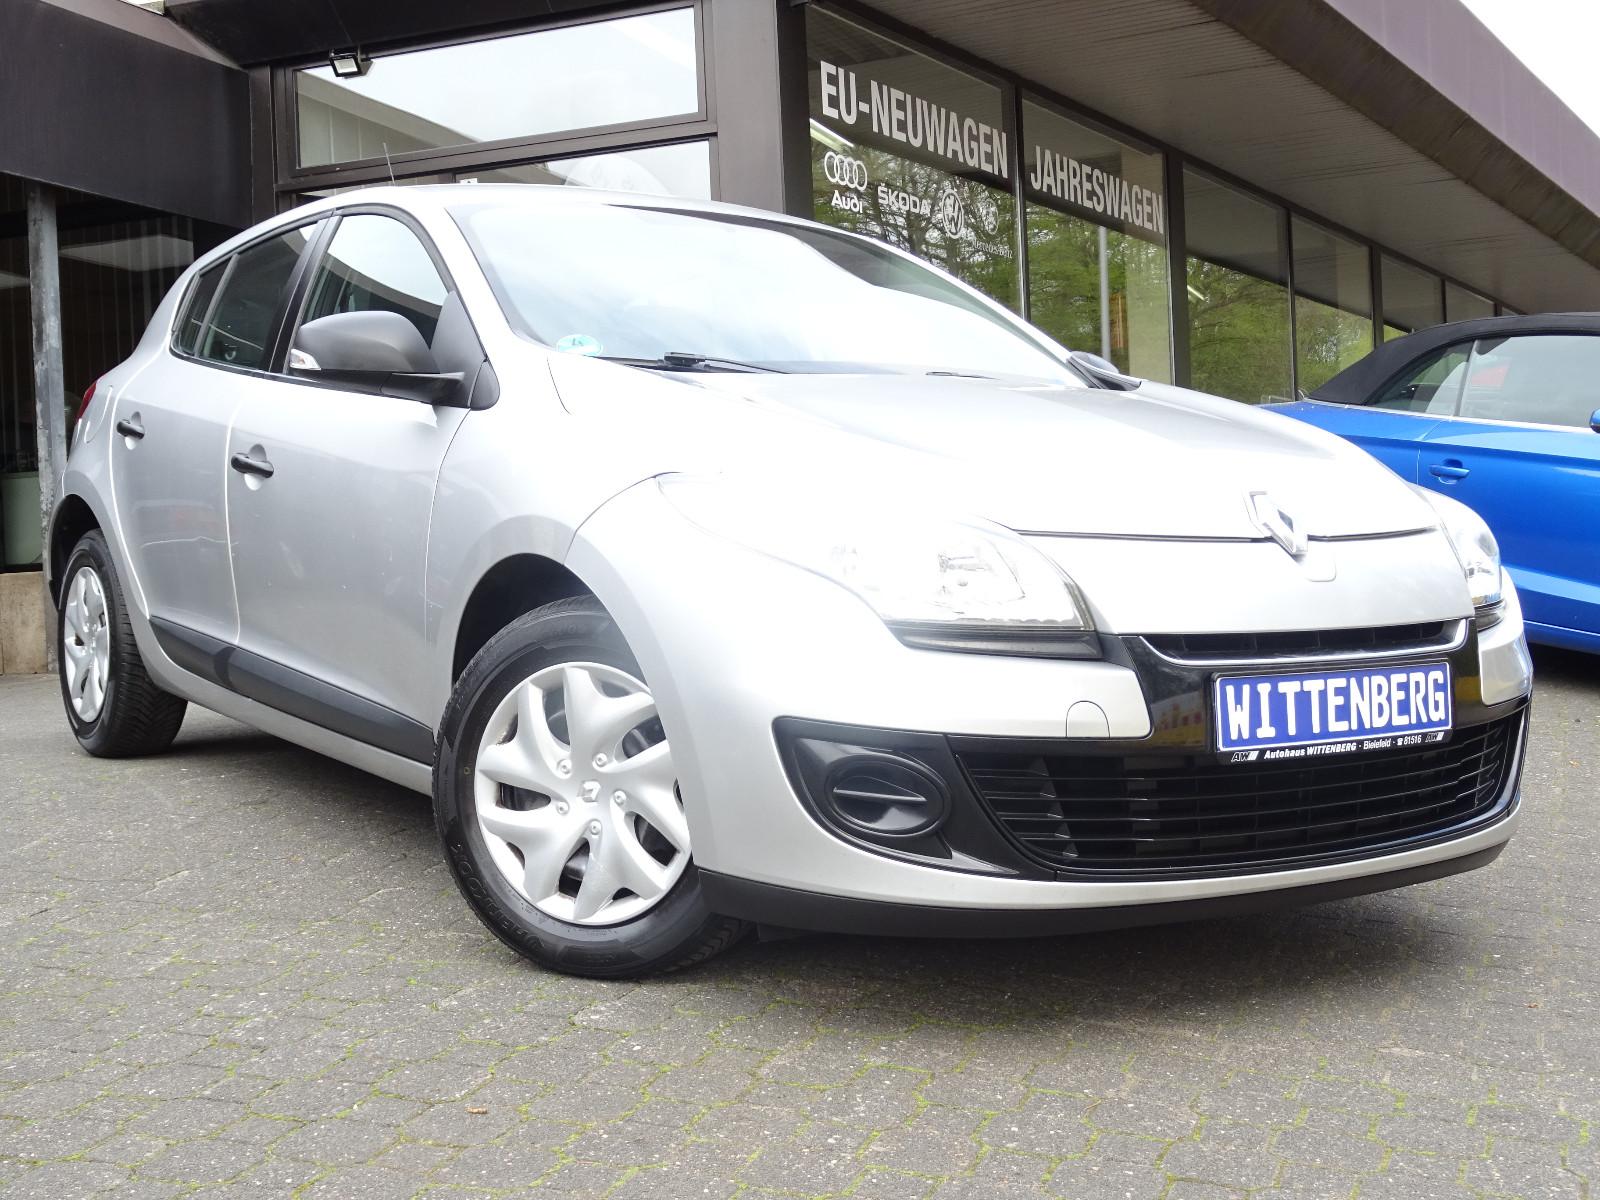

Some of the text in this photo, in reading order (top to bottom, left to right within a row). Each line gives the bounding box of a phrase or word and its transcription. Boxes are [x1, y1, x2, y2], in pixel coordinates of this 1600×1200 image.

[820, 60, 1008, 178] EU-NEUWAGEN
[831, 190, 863, 213] Audi
[1030, 145, 1164, 234] JAHRESWAGEN
[1226, 670, 1446, 740] WITTENBERG
[1264, 749, 1305, 759] Autohaus
[1307, 743, 1357, 756] WITTENBERG
[1363, 738, 1392, 750] Bielefeld
